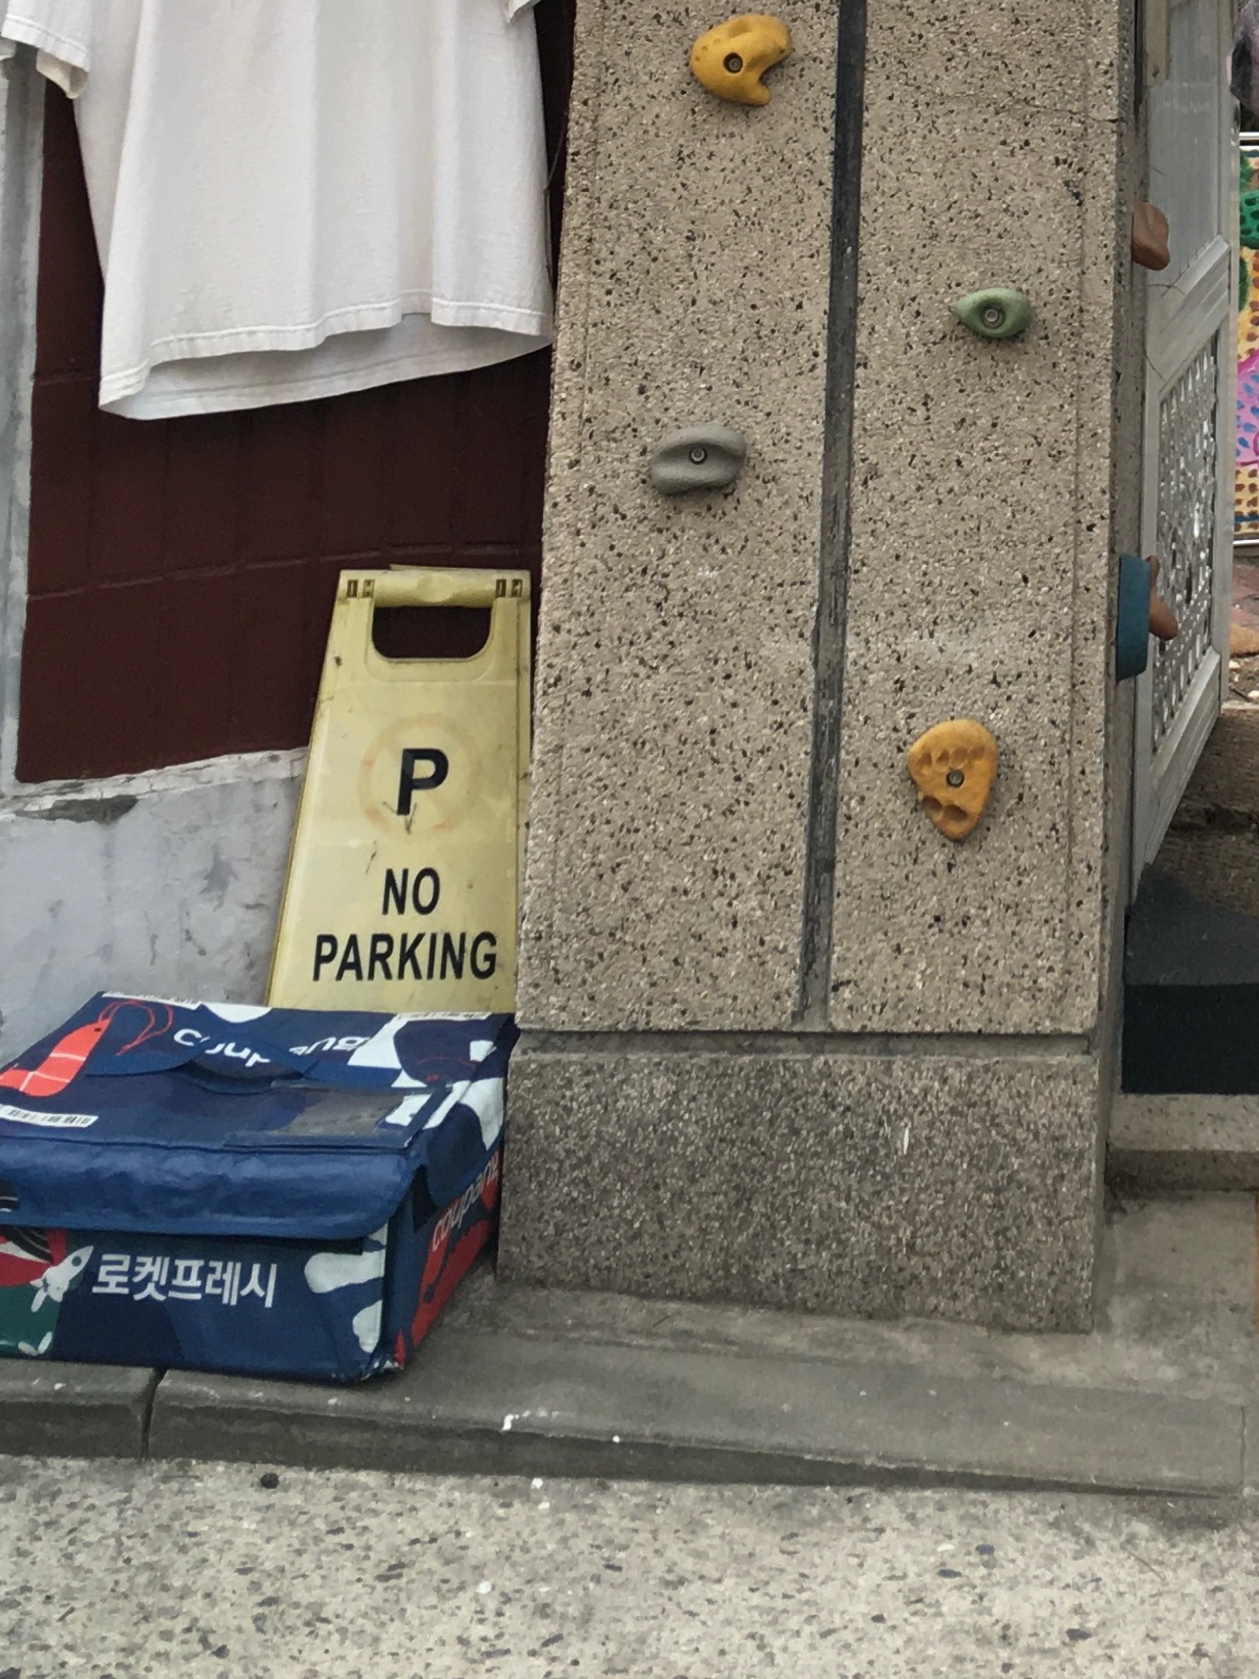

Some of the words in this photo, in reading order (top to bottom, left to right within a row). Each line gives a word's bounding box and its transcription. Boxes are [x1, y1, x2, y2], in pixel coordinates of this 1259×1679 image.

[397, 748, 449, 816] P
[382, 867, 441, 916] NO
[312, 931, 497, 982] PARKING
[92, 1253, 278, 1309] 로켓프레시
